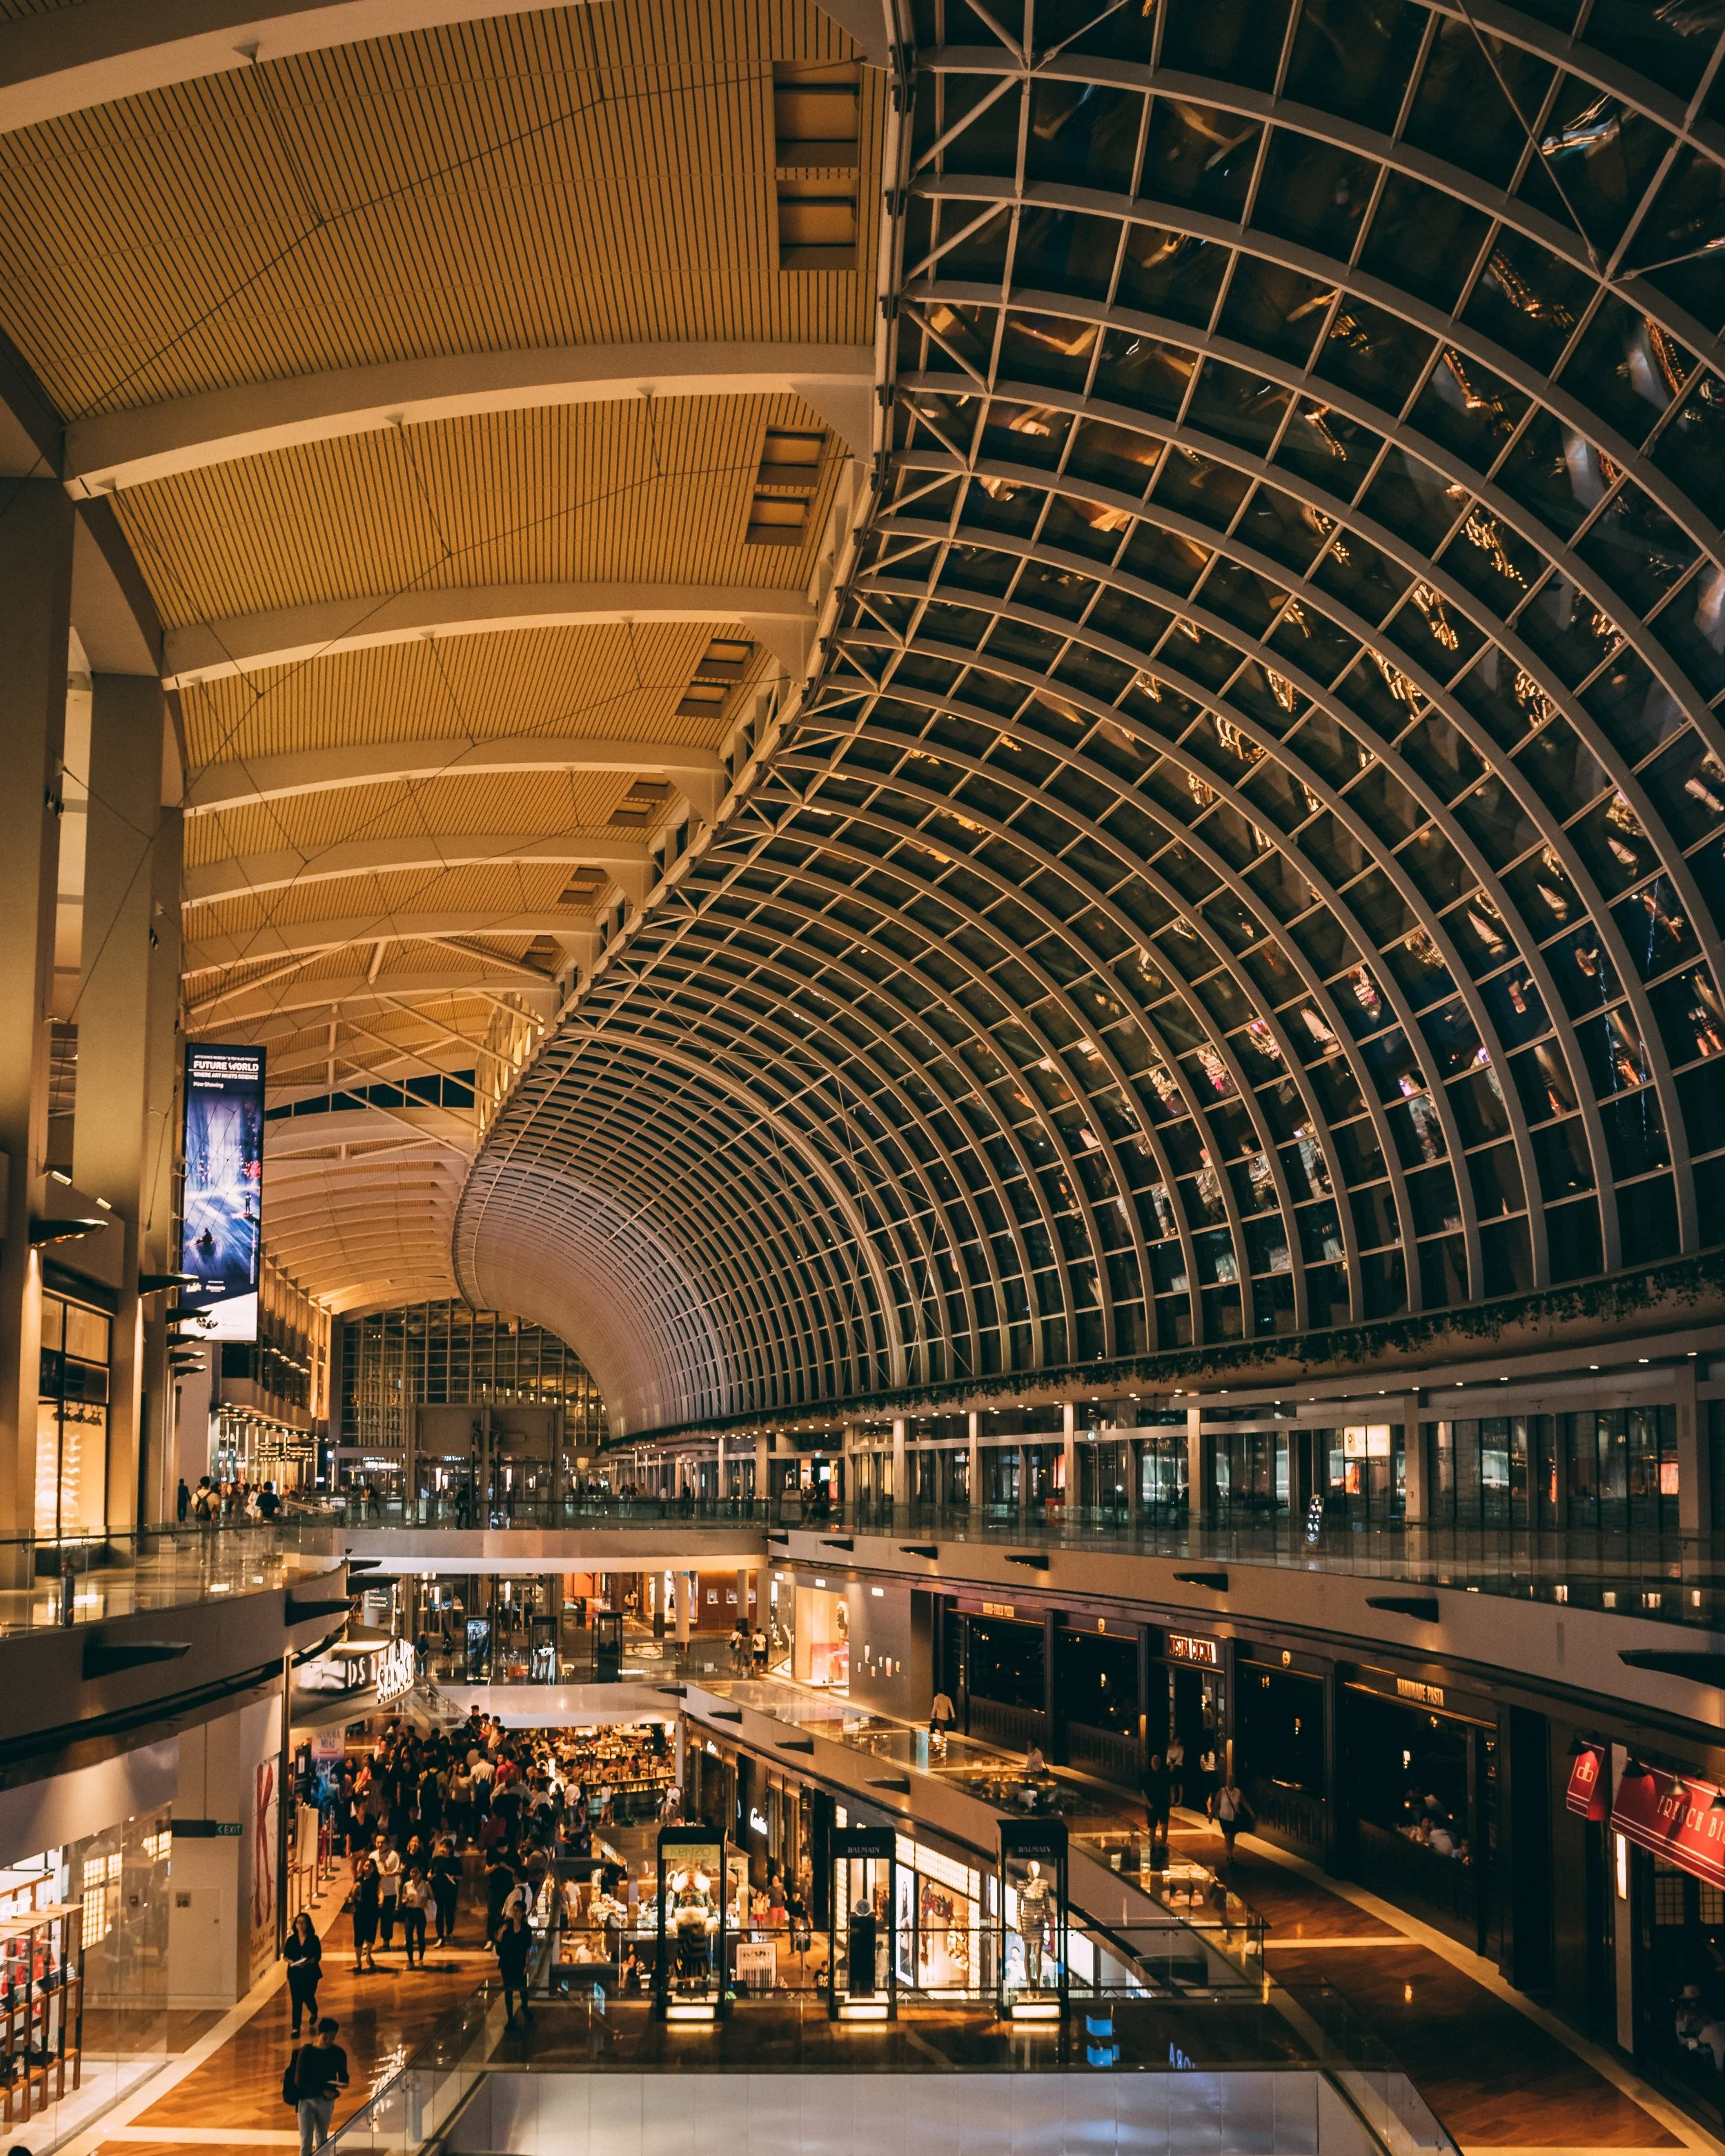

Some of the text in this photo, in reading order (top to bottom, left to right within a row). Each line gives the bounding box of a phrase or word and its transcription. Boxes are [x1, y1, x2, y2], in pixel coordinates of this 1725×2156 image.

[193, 1060, 259, 1071] FUTURE WORLD
[1426, 1685, 1443, 1707] PASTA
[224, 1825, 240, 1834] EXIT
[1708, 1817, 1725, 1844] BI
[671, 1847, 711, 1857] KENZO
